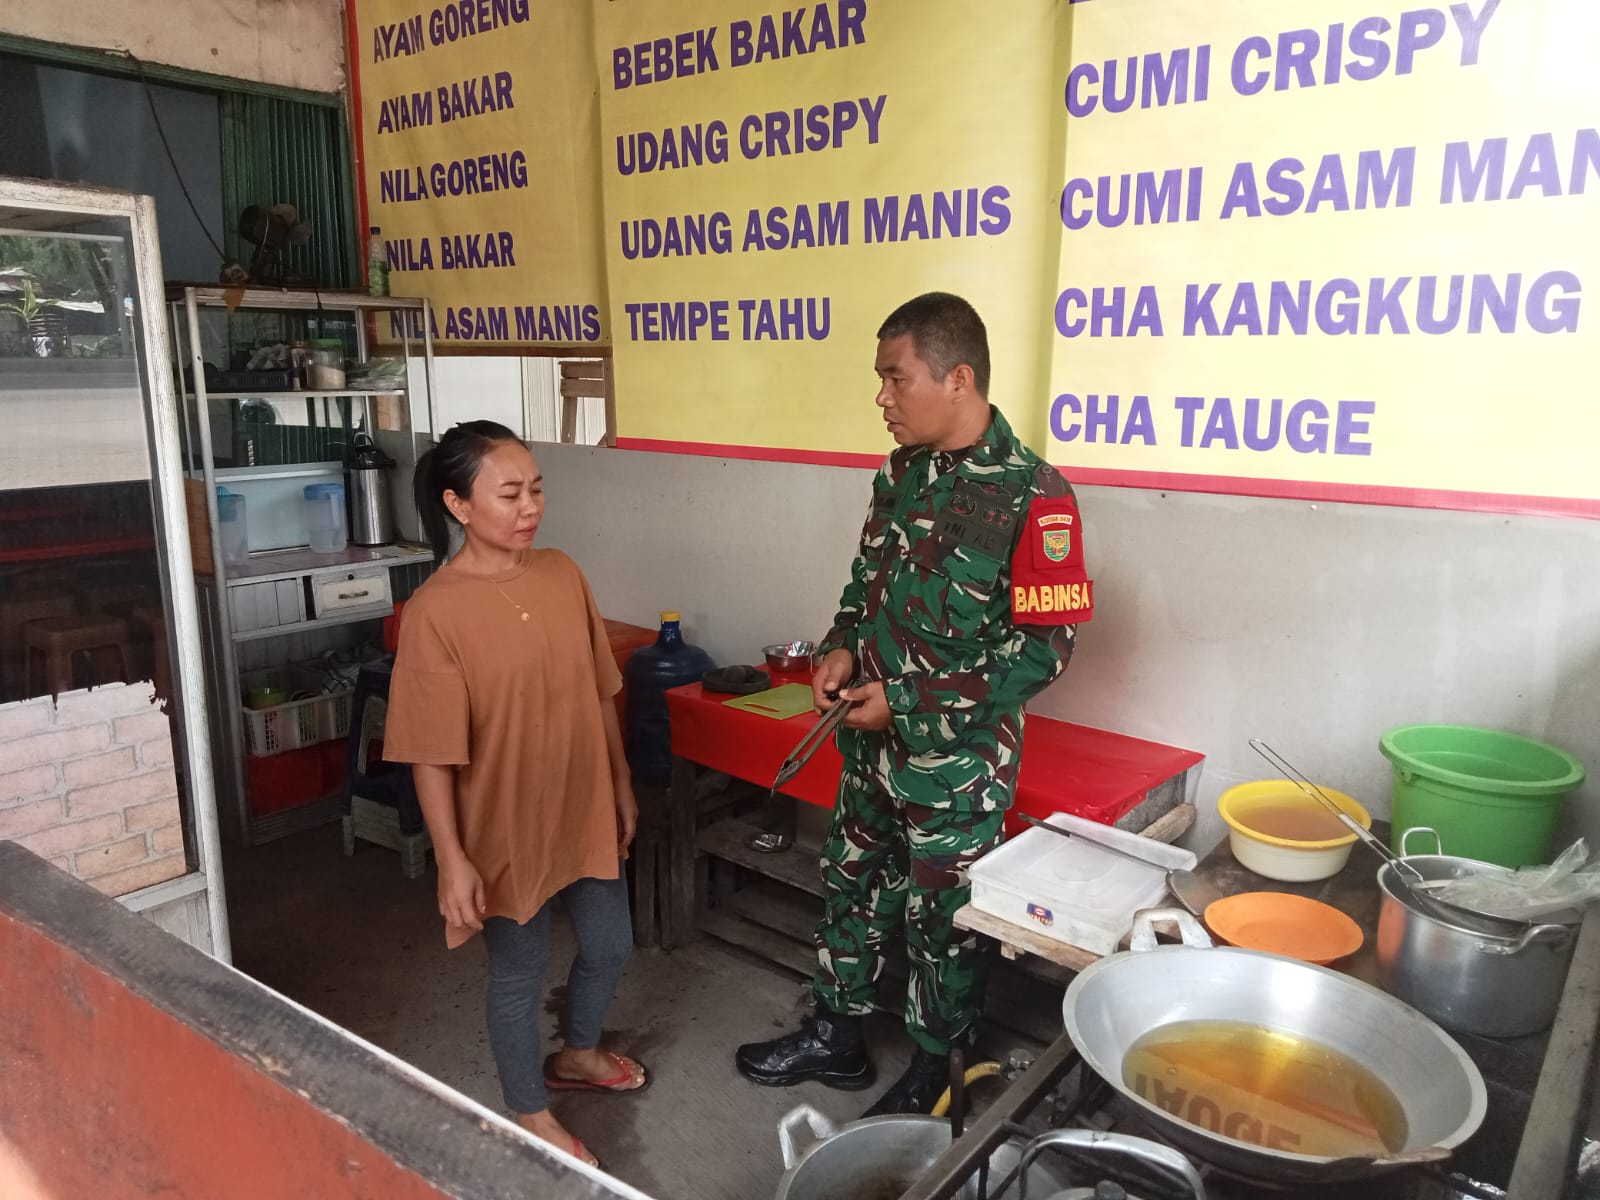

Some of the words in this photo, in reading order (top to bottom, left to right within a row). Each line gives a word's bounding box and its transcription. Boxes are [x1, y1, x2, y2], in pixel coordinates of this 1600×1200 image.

[374, 14, 425, 64] AYAM
[429, 0, 530, 47] GORENG
[614, 27, 718, 89] BEBEK
[731, 0, 866, 67] BAKAR
[1066, 45, 1210, 117] CUMI
[1232, 0, 1499, 95] CRISPY
[378, 91, 433, 134] AYAM
[438, 72, 513, 123] BAKAR
[617, 121, 728, 175] UDANG
[740, 96, 886, 159] CRISPY
[381, 168, 428, 202] NILA
[430, 151, 528, 197] GORENG
[1061, 167, 1202, 229] CUMI
[1221, 147, 1415, 219] ASAM
[385, 237, 433, 272] NILA
[441, 232, 515, 270] BAKAR
[622, 212, 732, 259] UDANG
[744, 201, 849, 251] ASAM
[865, 185, 1011, 242] MANIS
[446, 307, 508, 340] ASAM
[515, 305, 600, 341] MANIS
[626, 301, 729, 340] TEMPE
[739, 297, 830, 340] TAHU
[1056, 286, 1163, 337] CHA
[1184, 271, 1580, 336] KANGKUNG
[1050, 394, 1156, 445] CHA
[1175, 397, 1375, 455] TAUGE
[943, 521, 966, 540] TNI
[1014, 582, 1090, 613] BABINSA
